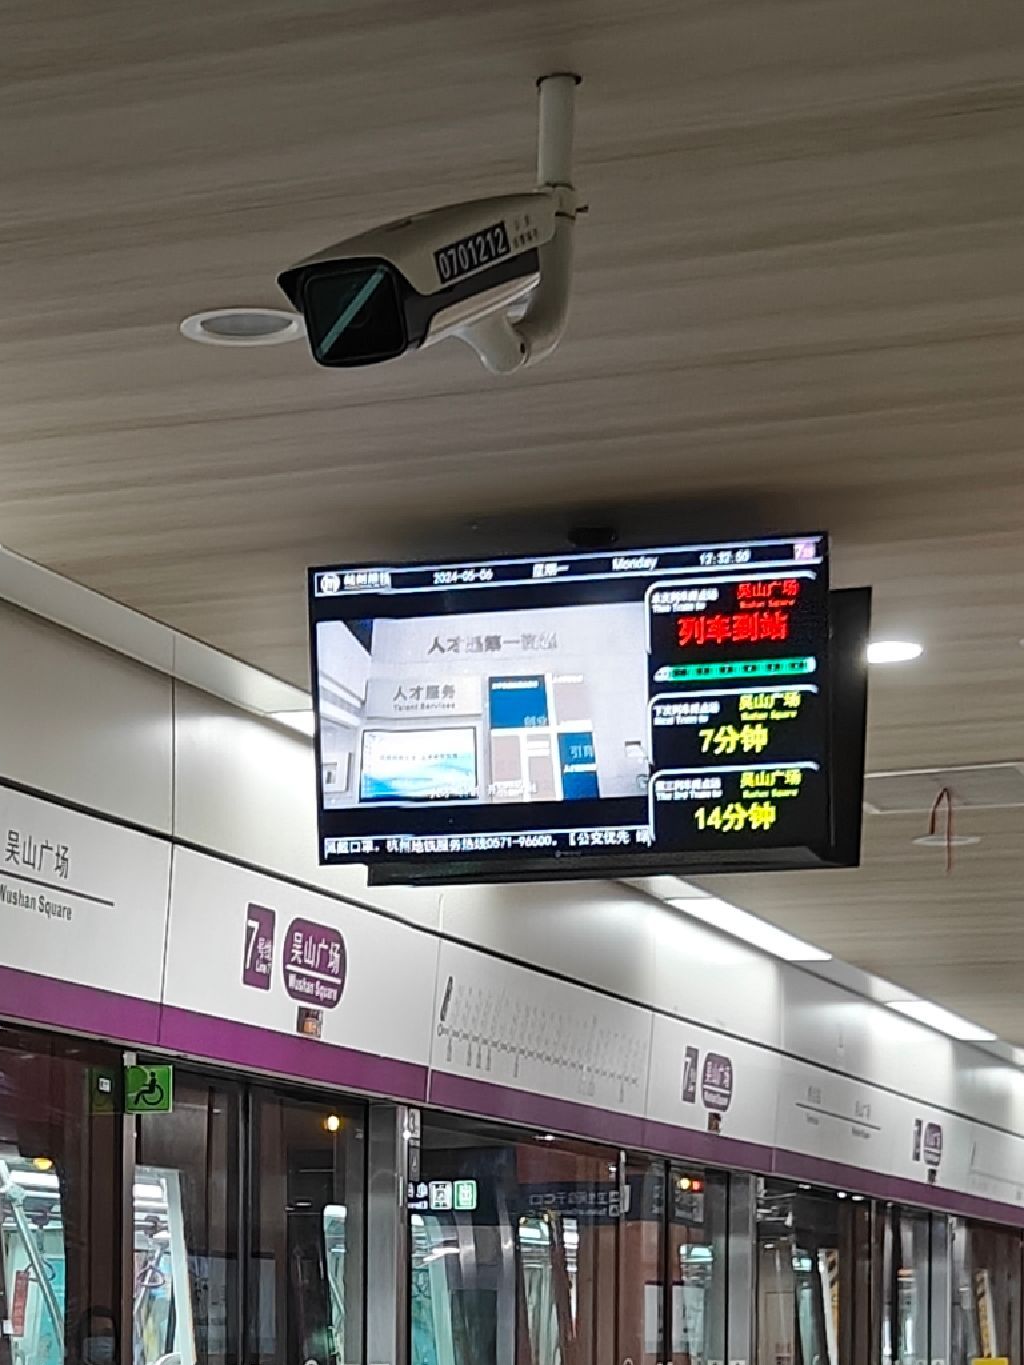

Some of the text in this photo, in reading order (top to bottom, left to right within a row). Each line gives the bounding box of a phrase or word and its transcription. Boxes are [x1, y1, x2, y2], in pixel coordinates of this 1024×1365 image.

[438, 225, 507, 281] 0701212
[678, 611, 788, 646] 列车到站
[698, 724, 769, 754] 7分钟
[694, 801, 776, 832] 14分钟
[4, 829, 69, 878] 吴山广场
[38, 894, 73, 921] Square
[290, 932, 341, 974] 吴山广场
